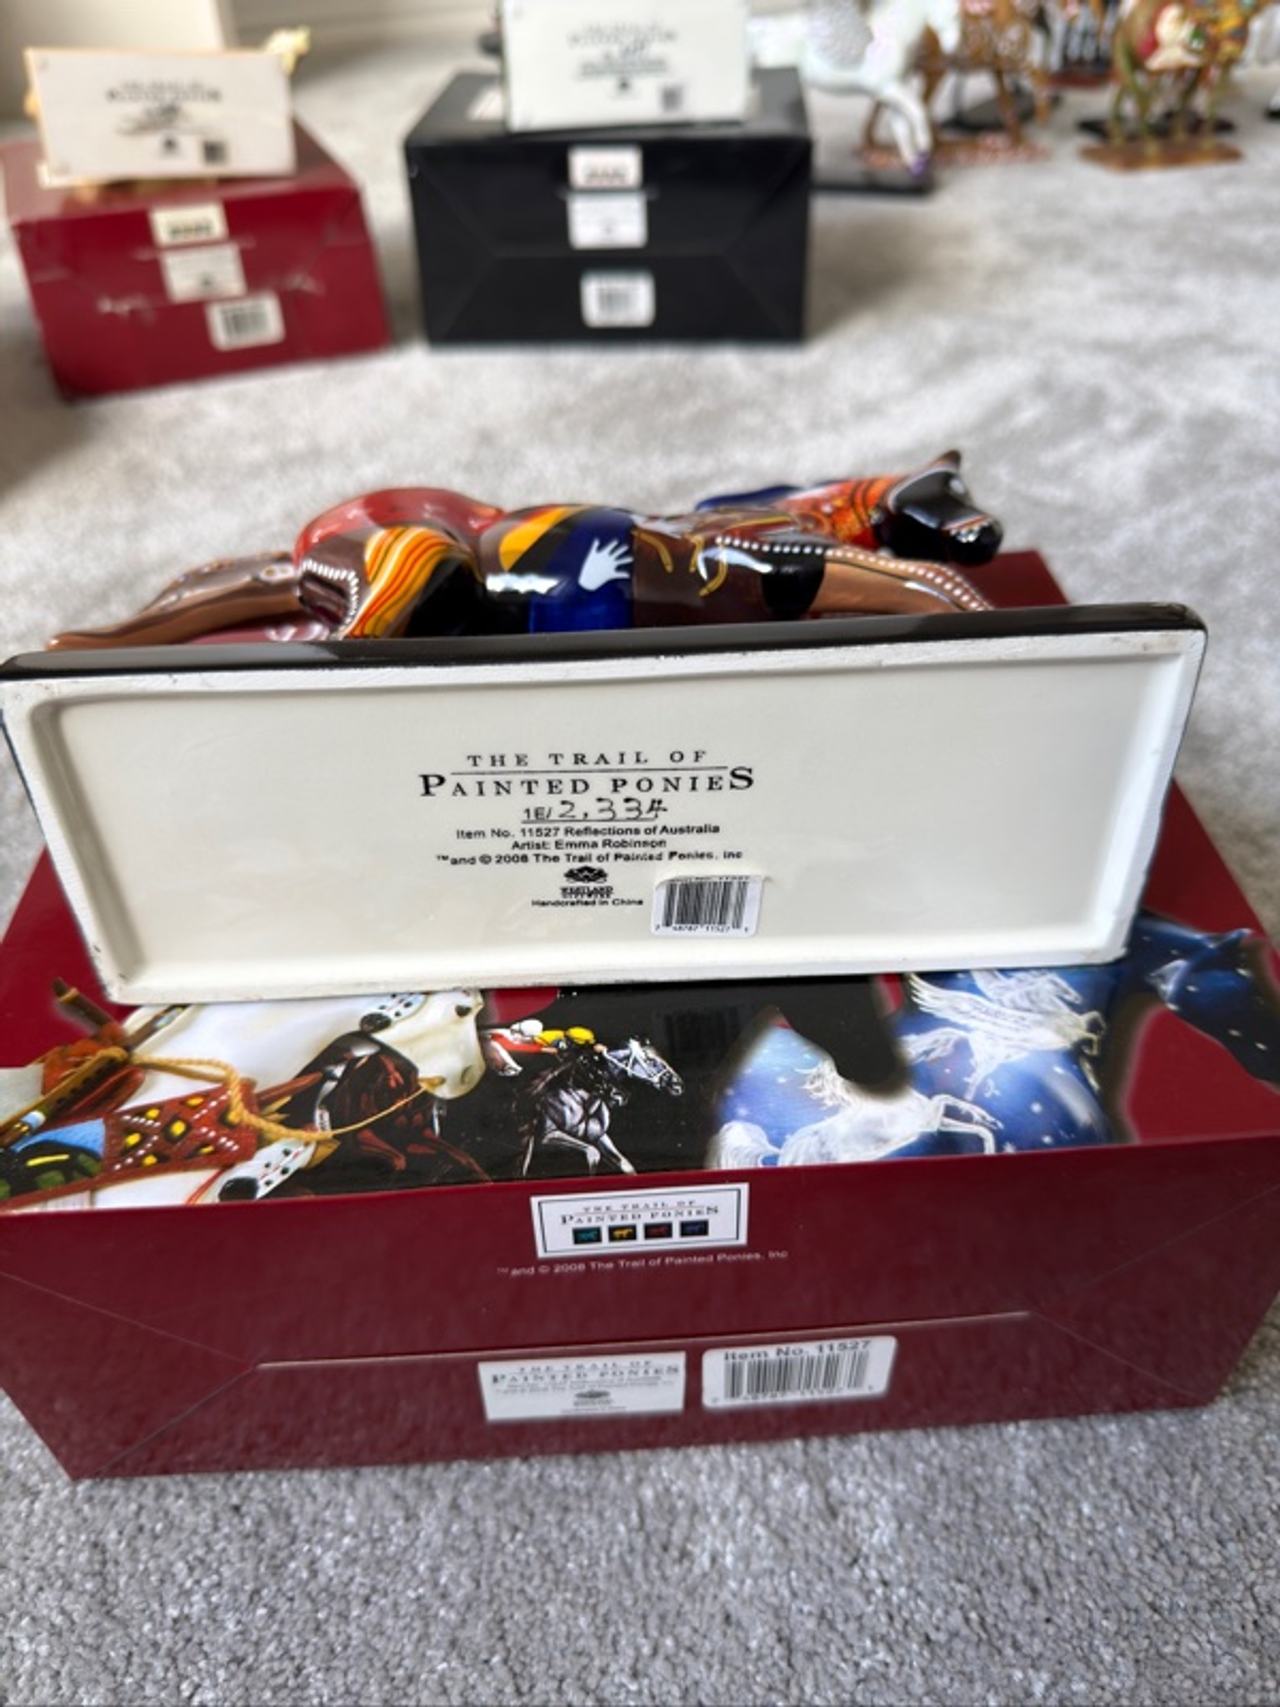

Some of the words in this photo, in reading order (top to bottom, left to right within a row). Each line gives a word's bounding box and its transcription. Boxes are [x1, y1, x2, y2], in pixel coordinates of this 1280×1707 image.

[467, 753, 528, 767] THE
[549, 751, 648, 765] TRAIL
[670, 750, 705, 763] OF
[418, 774, 590, 797] PAINTED
[611, 766, 754, 794] PONIES
[456, 829, 485, 839] Item
[491, 829, 515, 838] No.
[521, 827, 560, 837] 11527
[564, 826, 640, 837] Reflections
[644, 825, 656, 835] of
[659, 824, 720, 835] Australia
[512, 840, 551, 850] Artist:
[555, 840, 598, 850] Emma
[602, 839, 667, 849] Robinson
[533, 853, 560, 863] The
[565, 853, 592, 863] Trail
[596, 853, 609, 862] of
[614, 852, 663, 862] Painted
[531, 899, 596, 907] Handcrafted
[612, 898, 643, 906] China
[561, 1212, 642, 1225] PAINTED
[590, 1261, 614, 1270] The
[618, 1259, 646, 1268] Trail
[648, 1258, 661, 1266] of
[665, 1254, 714, 1265] Painted
[724, 1351, 769, 1361] Item
[776, 1346, 810, 1357] No.
[816, 1340, 871, 1354] 11527
